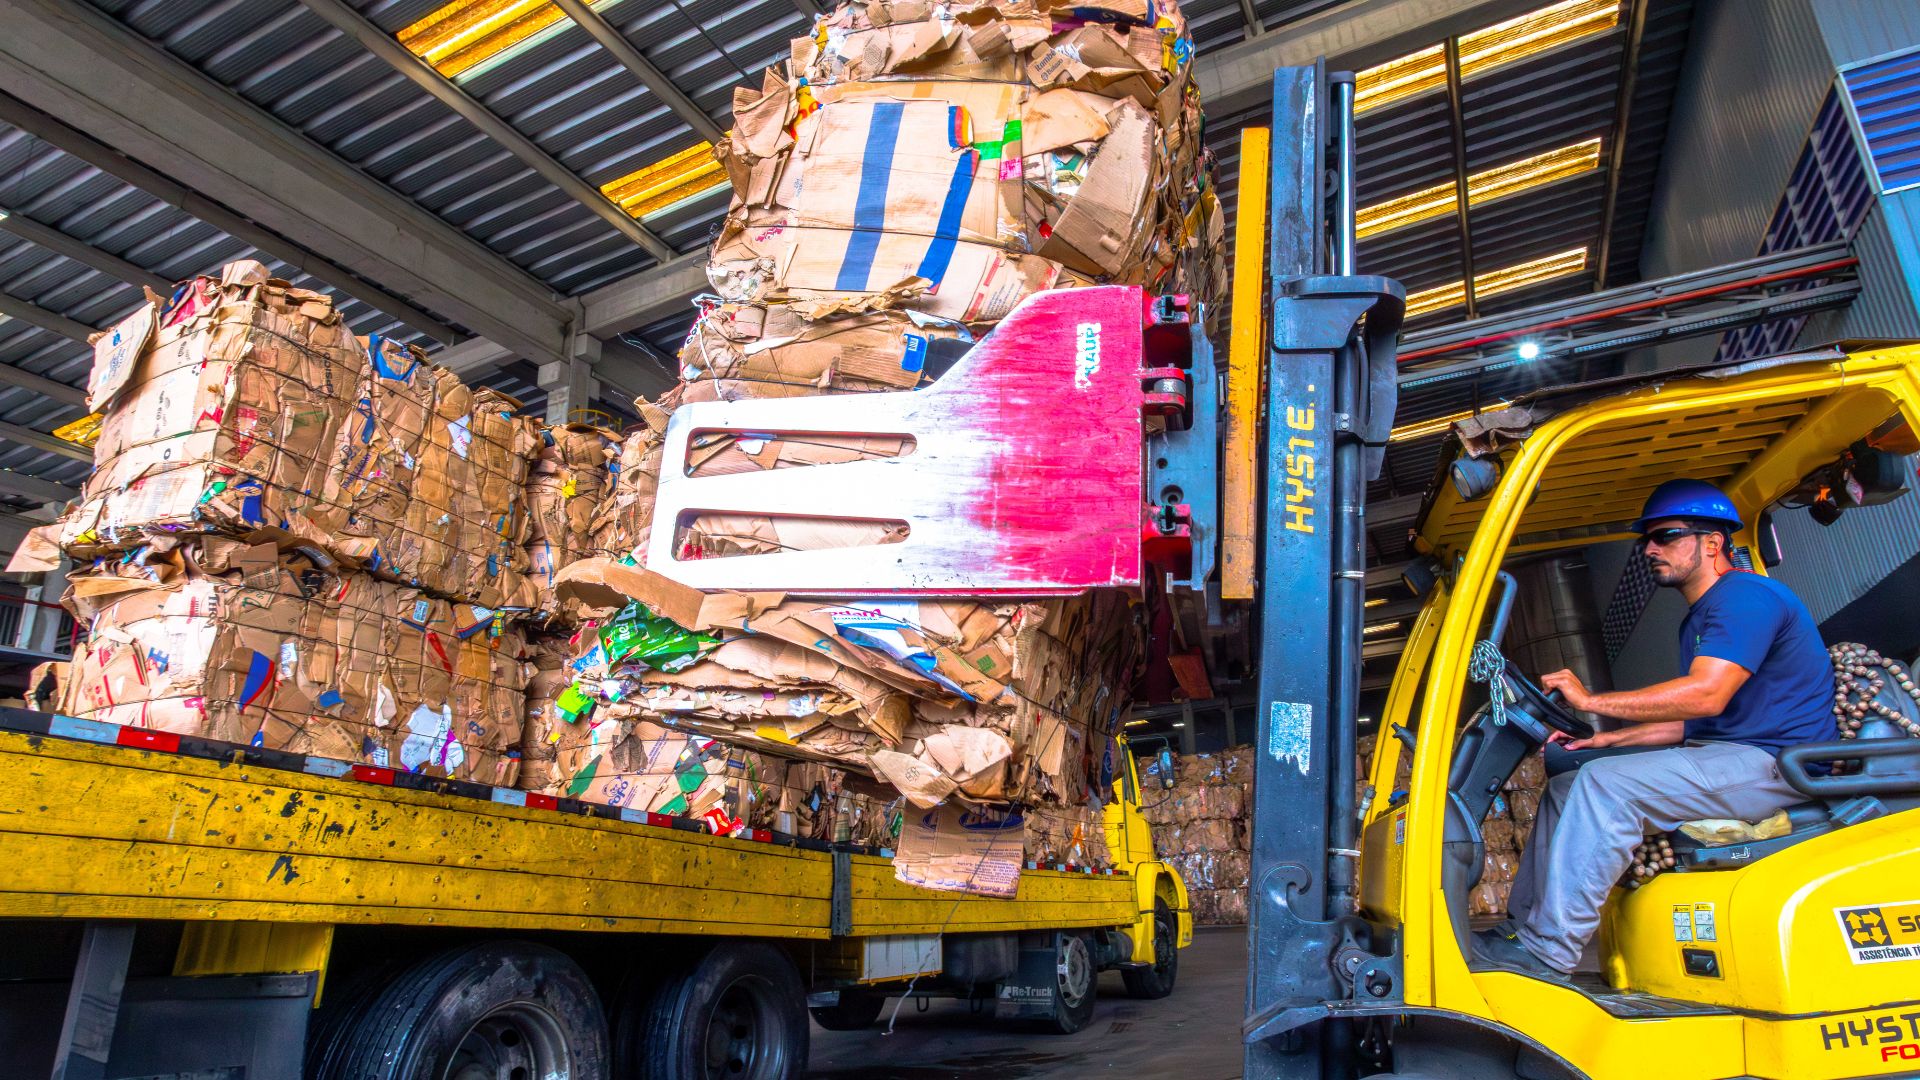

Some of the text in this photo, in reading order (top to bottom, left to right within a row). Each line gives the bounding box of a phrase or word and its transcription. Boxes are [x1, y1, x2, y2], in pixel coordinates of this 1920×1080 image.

[1285, 385, 1315, 533] HYSTE
[1858, 947, 1912, 961] ASSISTÊNCIA
[1012, 986, 1052, 997] Re-Truck
